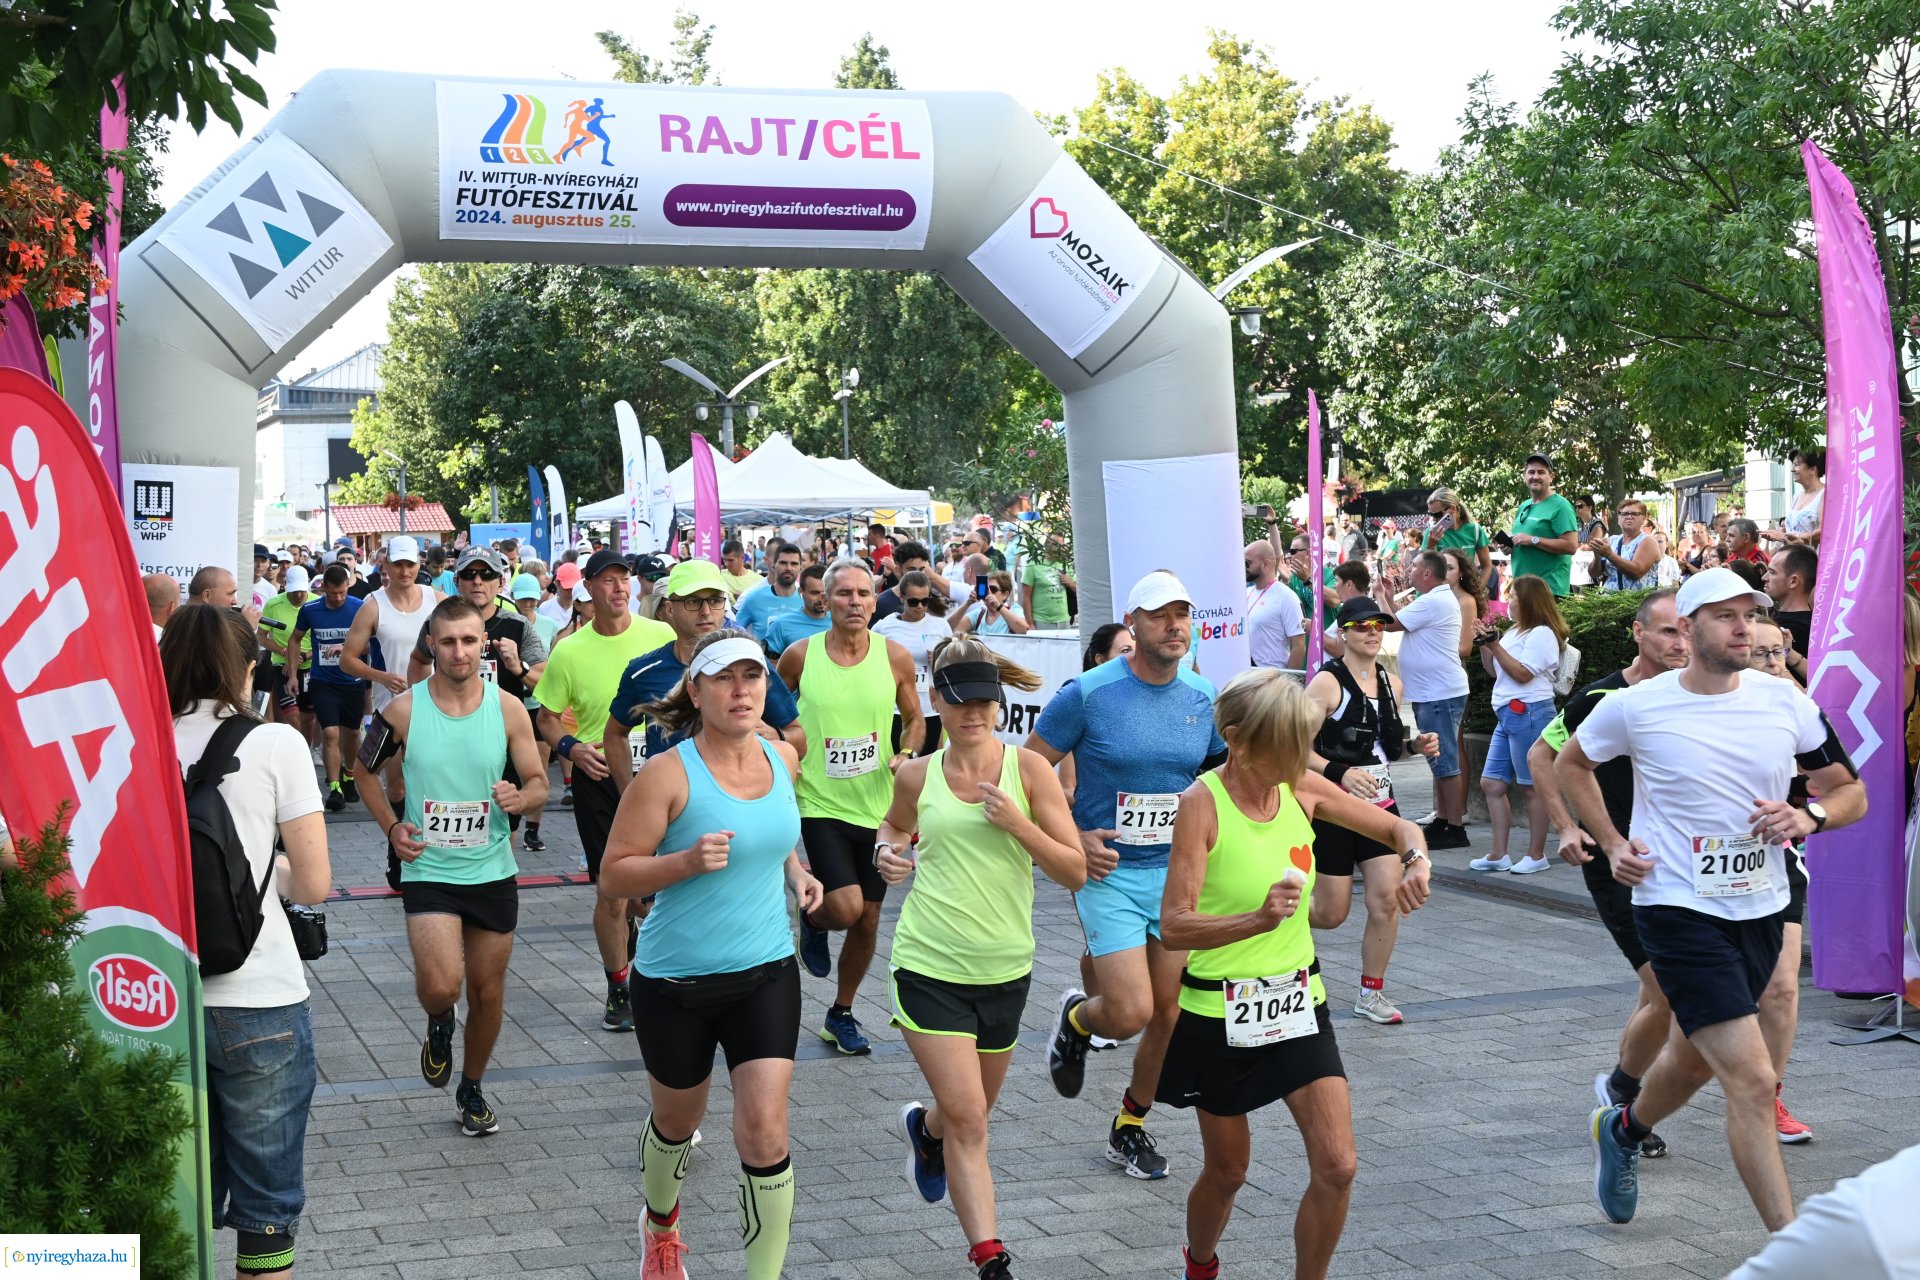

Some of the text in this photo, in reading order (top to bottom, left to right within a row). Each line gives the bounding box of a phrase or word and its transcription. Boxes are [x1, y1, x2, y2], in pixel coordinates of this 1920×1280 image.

[659, 112, 921, 161] RAJT/CÉL
[458, 170, 639, 189] IV. WITTUR-NYÍREGYHÁZI
[456, 185, 639, 212] FUTÓFESZTIVÁL
[676, 200, 904, 217] www.nyiregyhazifutofesztival.hu
[455, 209, 636, 229] 2024. augusztus 25.
[284, 246, 344, 300] WITTUR
[1048, 249, 1058, 260] Az
[1056, 258, 1076, 276] orvosi
[1061, 230, 1130, 297] MOZAIK
[1100, 283, 1120, 304] med
[133, 521, 173, 531] SCOPE
[140, 531, 167, 541] WHP
[994, 703, 1045, 735] ORT
[830, 745, 875, 764] 21138
[429, 815, 485, 833] 21114
[1121, 810, 1178, 827] 21132
[1701, 848, 1765, 875] 21000
[1234, 990, 1305, 1024] 21042
